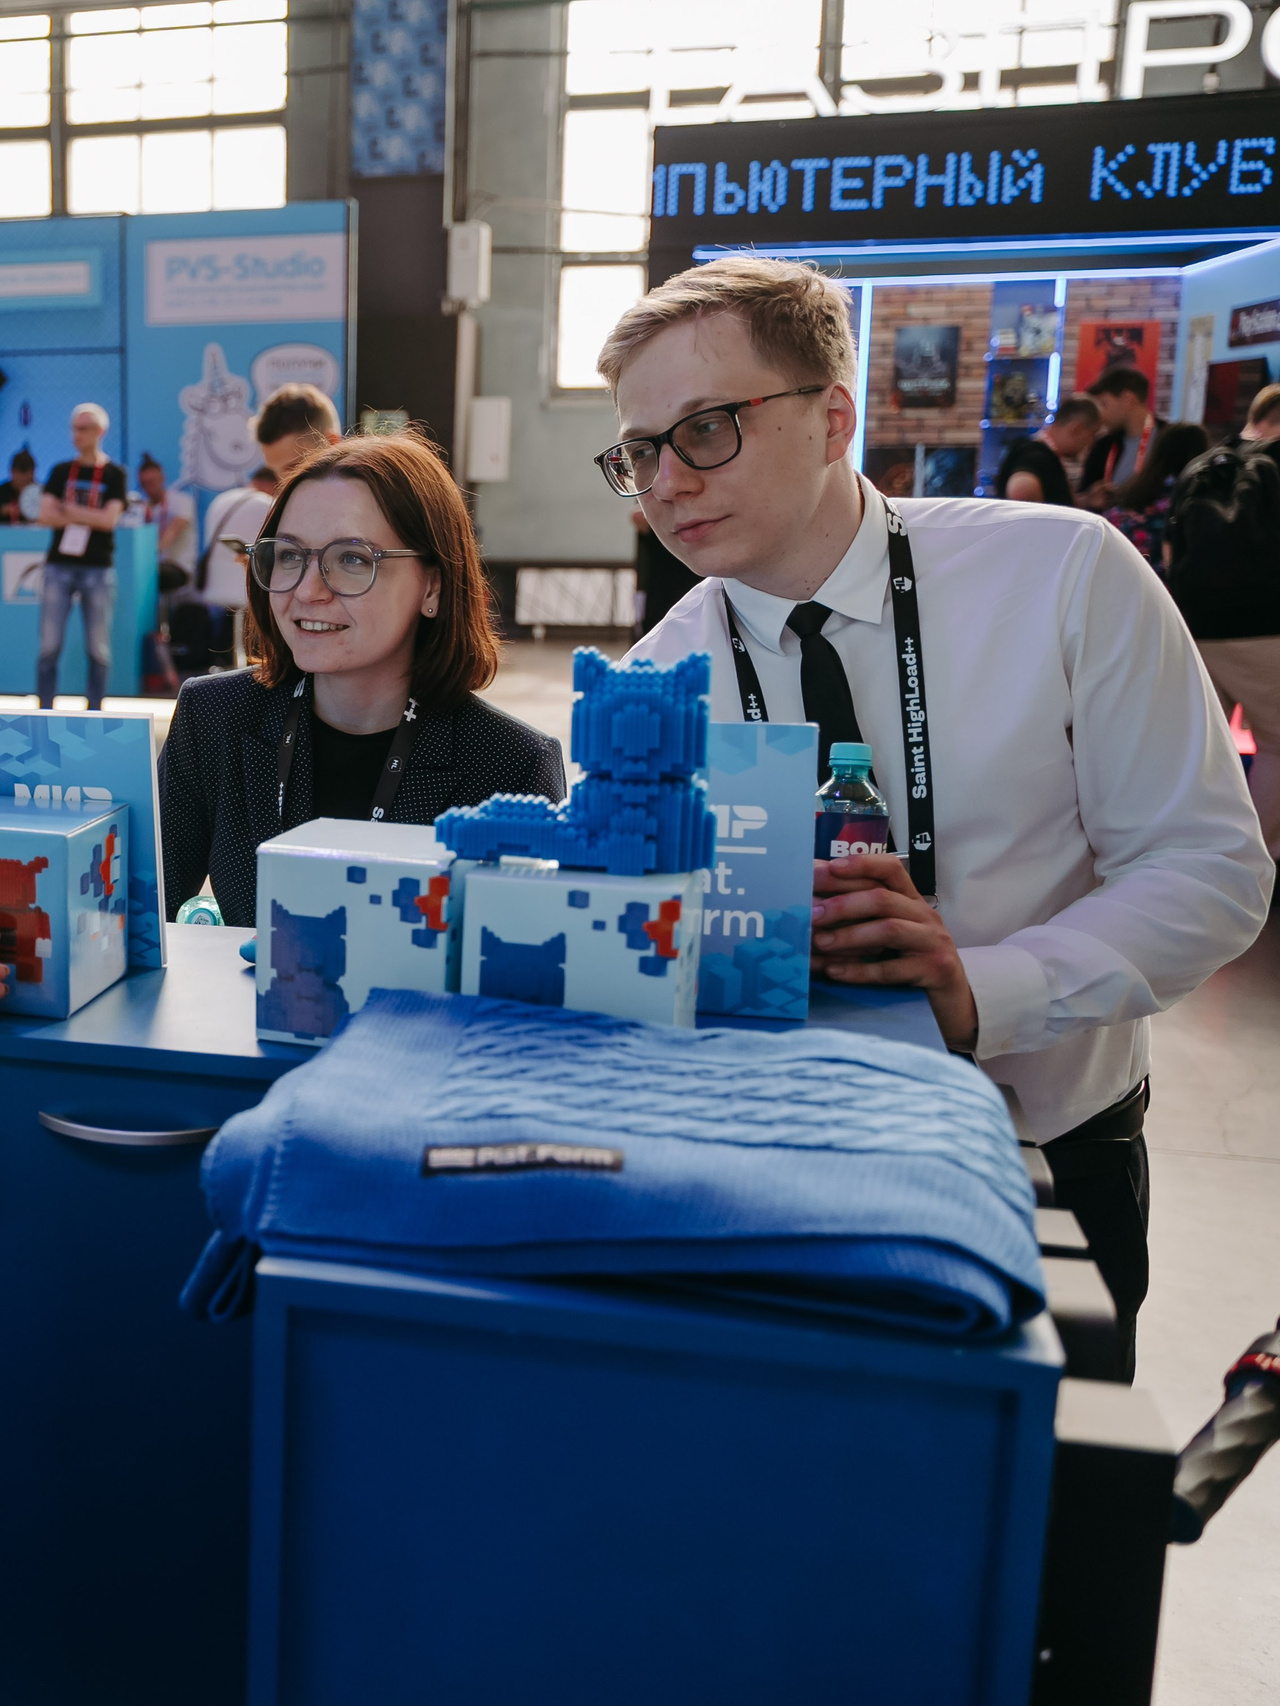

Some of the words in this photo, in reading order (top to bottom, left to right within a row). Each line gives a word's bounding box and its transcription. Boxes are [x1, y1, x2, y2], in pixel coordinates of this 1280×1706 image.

[654, 148, 1045, 217] ПЬЮТЕРНЫЙ
[1089, 136, 1276, 201] КЛУБ
[166, 251, 326, 281] PVS-Studio
[901, 636, 925, 743] HighLoad++
[911, 745, 928, 800] Saint
[703, 908, 765, 938] rm
